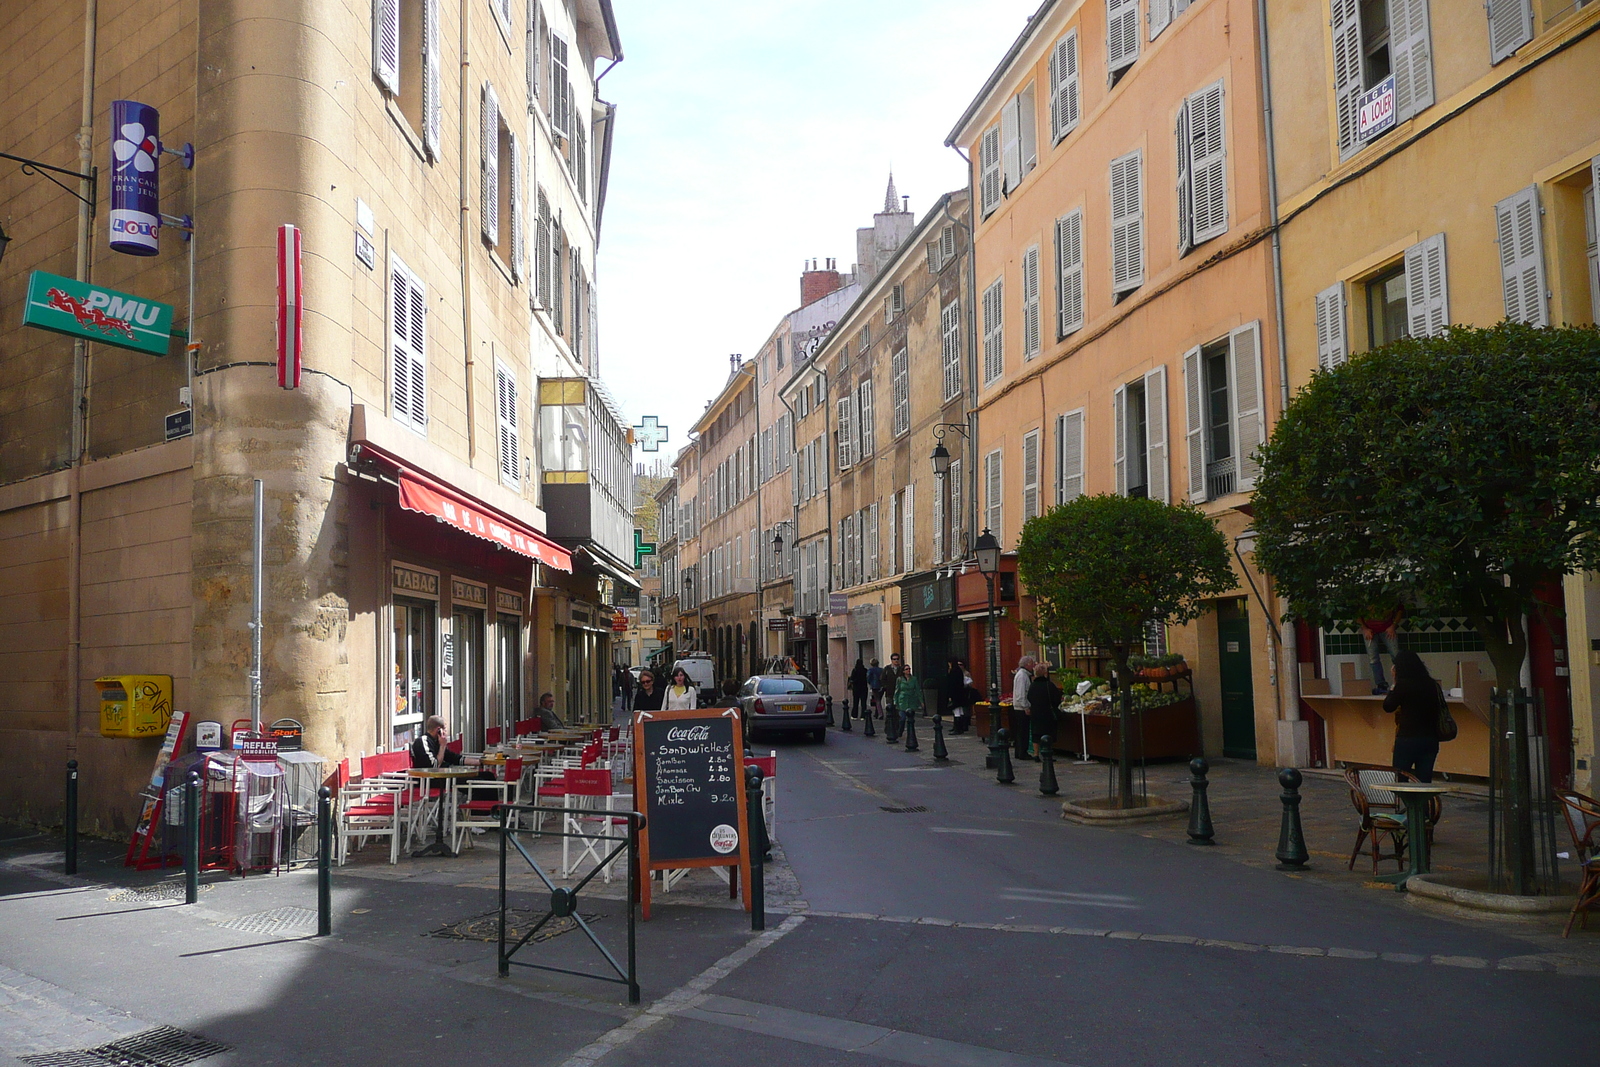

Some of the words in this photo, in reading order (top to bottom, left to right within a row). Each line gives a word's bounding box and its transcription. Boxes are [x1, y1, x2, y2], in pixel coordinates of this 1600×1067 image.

[1361, 110, 1367, 128] A
[1372, 94, 1392, 121] LOUER
[137, 187, 158, 199] JEUX
[112, 218, 158, 240] LOTO
[87, 290, 161, 327] PMU
[394, 568, 436, 592] TABAC
[456, 583, 481, 602] BAR
[667, 725, 712, 742] Coca-Cola
[243, 741, 278, 749] REFLEX
[708, 774, 731, 782] 2.80
[711, 793, 735, 803] 3.20
